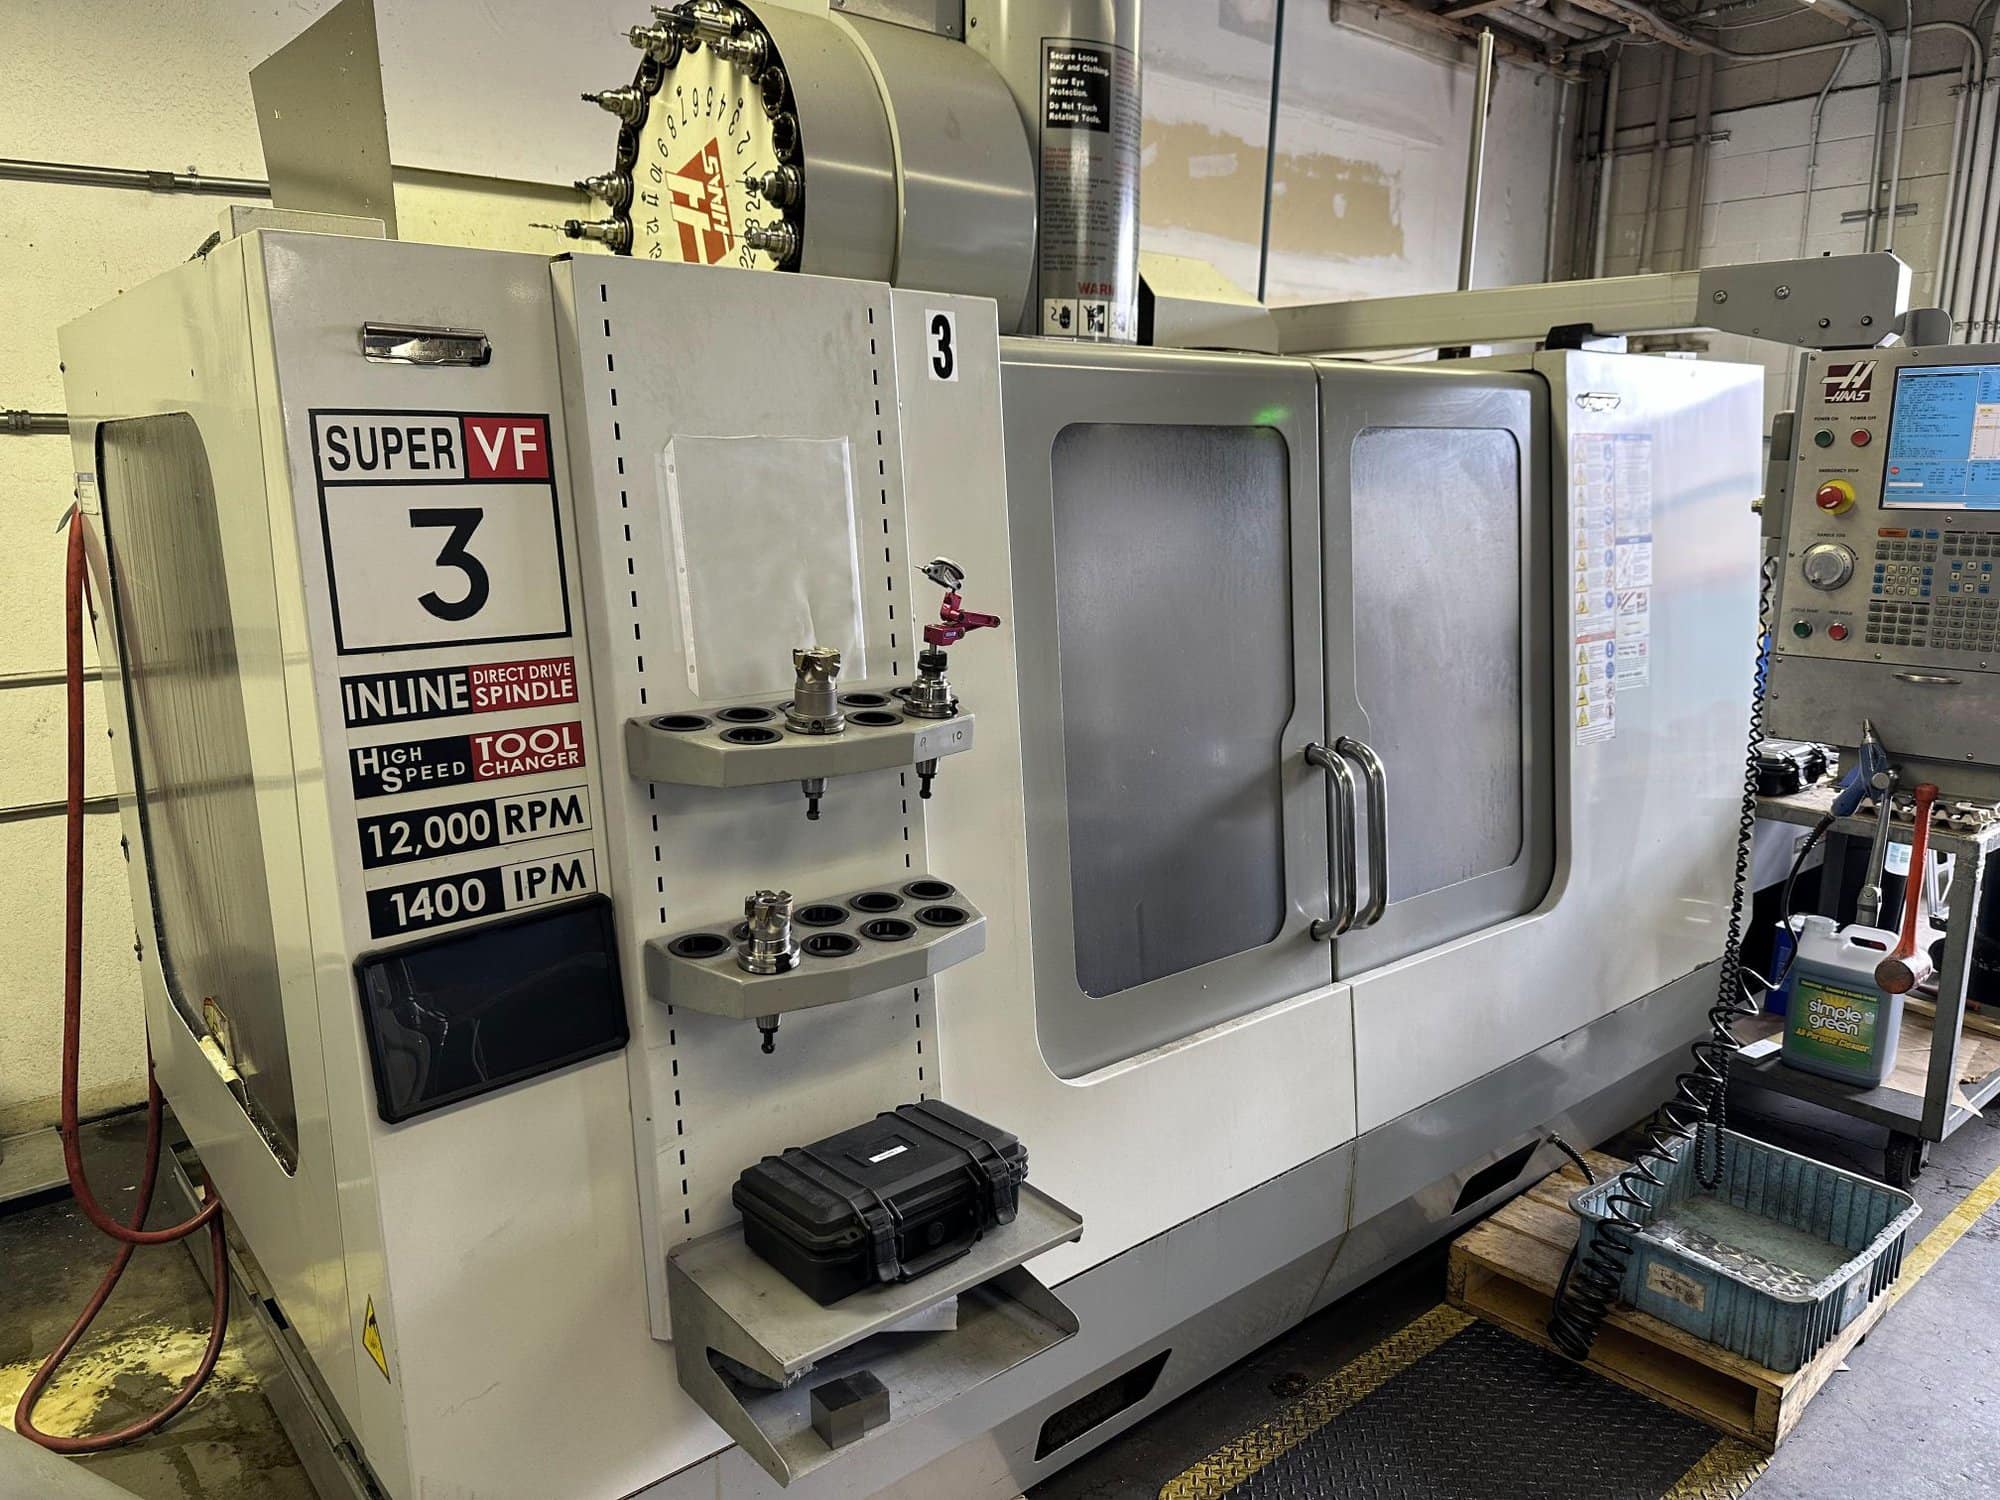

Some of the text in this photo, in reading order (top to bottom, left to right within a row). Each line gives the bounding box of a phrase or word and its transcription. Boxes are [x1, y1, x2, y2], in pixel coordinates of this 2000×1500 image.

[1050, 51, 1098, 62] Secure Loose
[1067, 64, 1080, 72] and
[1049, 88, 1088, 97] Protection.
[1050, 77, 1085, 87] Wear Eye
[692, 88, 699, 118] 6
[706, 86, 713, 117] 5
[717, 93, 726, 122] 4
[1049, 102, 1098, 112] Do Not Touch
[667, 114, 677, 140] 8
[1049, 112, 1079, 122] Rotating
[657, 137, 669, 158] 9
[737, 130, 751, 155] 2
[650, 162, 663, 184] 10
[647, 193, 659, 207] 11
[646, 216, 659, 236] 12
[931, 314, 953, 379] 3
[1824, 390, 1871, 402] HAAS
[326, 425, 538, 471] SUPER VF
[409, 508, 490, 621] 3
[473, 662, 572, 685] DIRECT DRIVE
[345, 673, 469, 721] INLINE
[475, 679, 573, 707] SPINDLE
[475, 727, 578, 762] TOOL
[479, 751, 579, 777] CHANGER
[368, 794, 584, 858] 12,000 RPM
[390, 859, 587, 926] 1400 IPM
[1809, 998, 1862, 1022] simple
[1809, 1014, 1858, 1035] green
